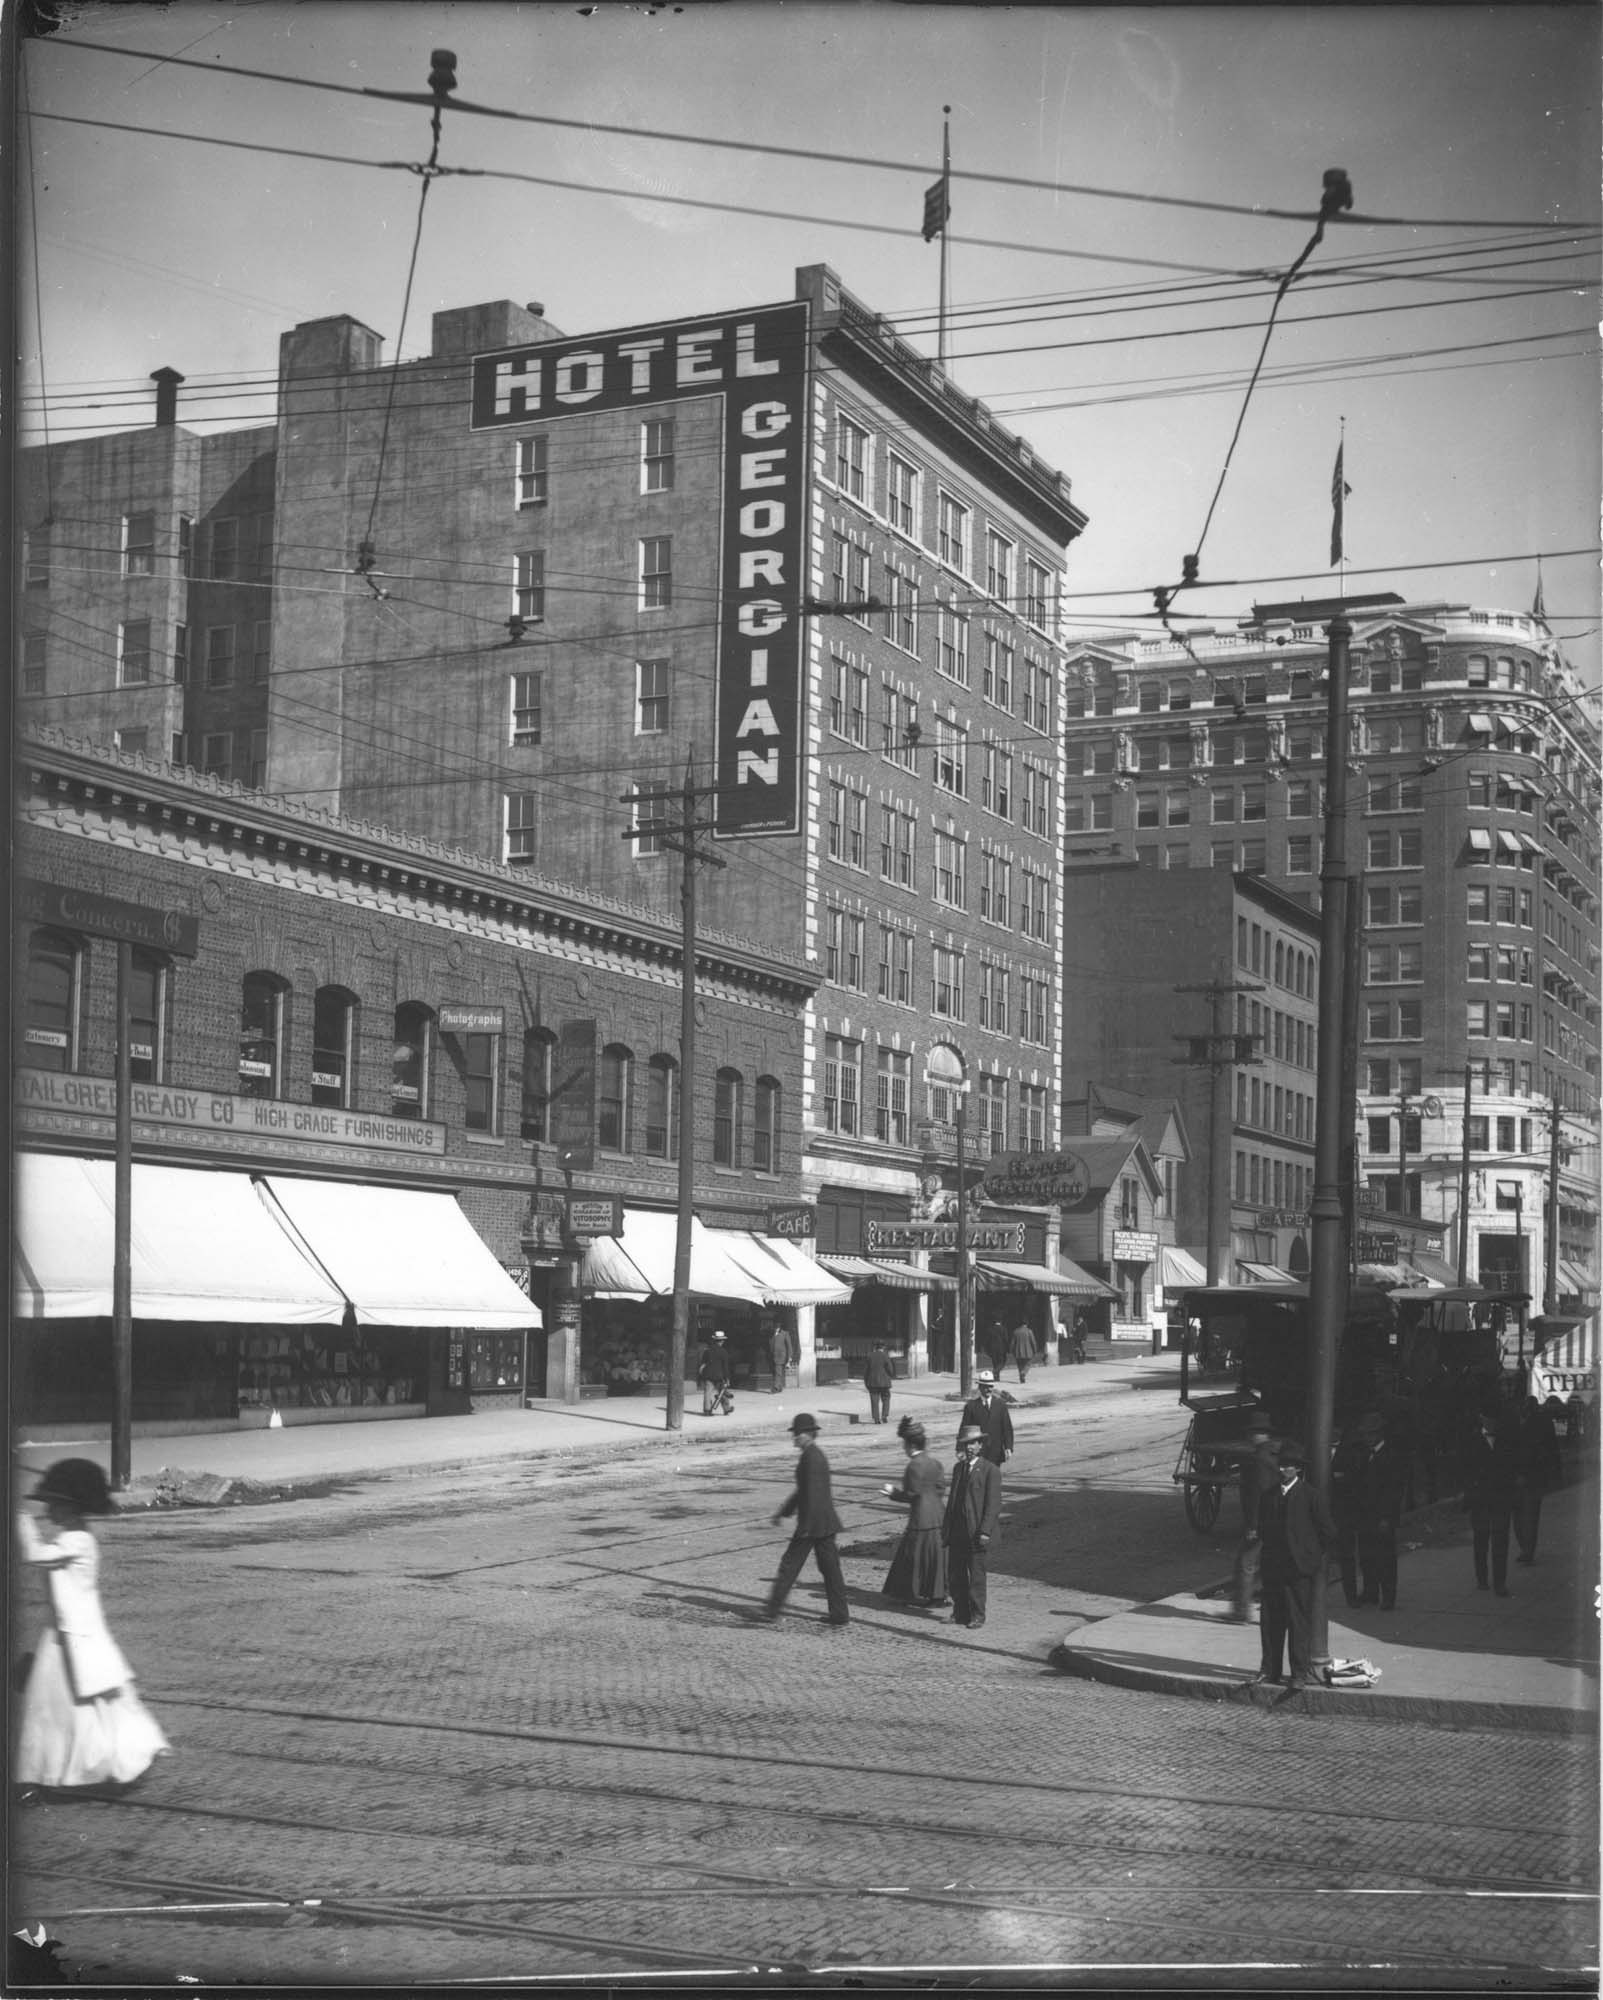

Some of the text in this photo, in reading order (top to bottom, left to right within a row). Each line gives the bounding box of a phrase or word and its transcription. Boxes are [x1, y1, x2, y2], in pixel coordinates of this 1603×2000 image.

[495, 324, 779, 416] HOTEL
[736, 400, 791, 785] GEORGIAN
[440, 1010, 503, 1027] Photographs
[133, 1090, 199, 1120] READY
[255, 1106, 287, 1129] HIGH
[294, 1112, 337, 1135] GRADE
[345, 1118, 433, 1147] FURNISHINGS
[877, 1229, 1013, 1249] RESTAUANT
[1543, 1373, 1594, 1392] THE
